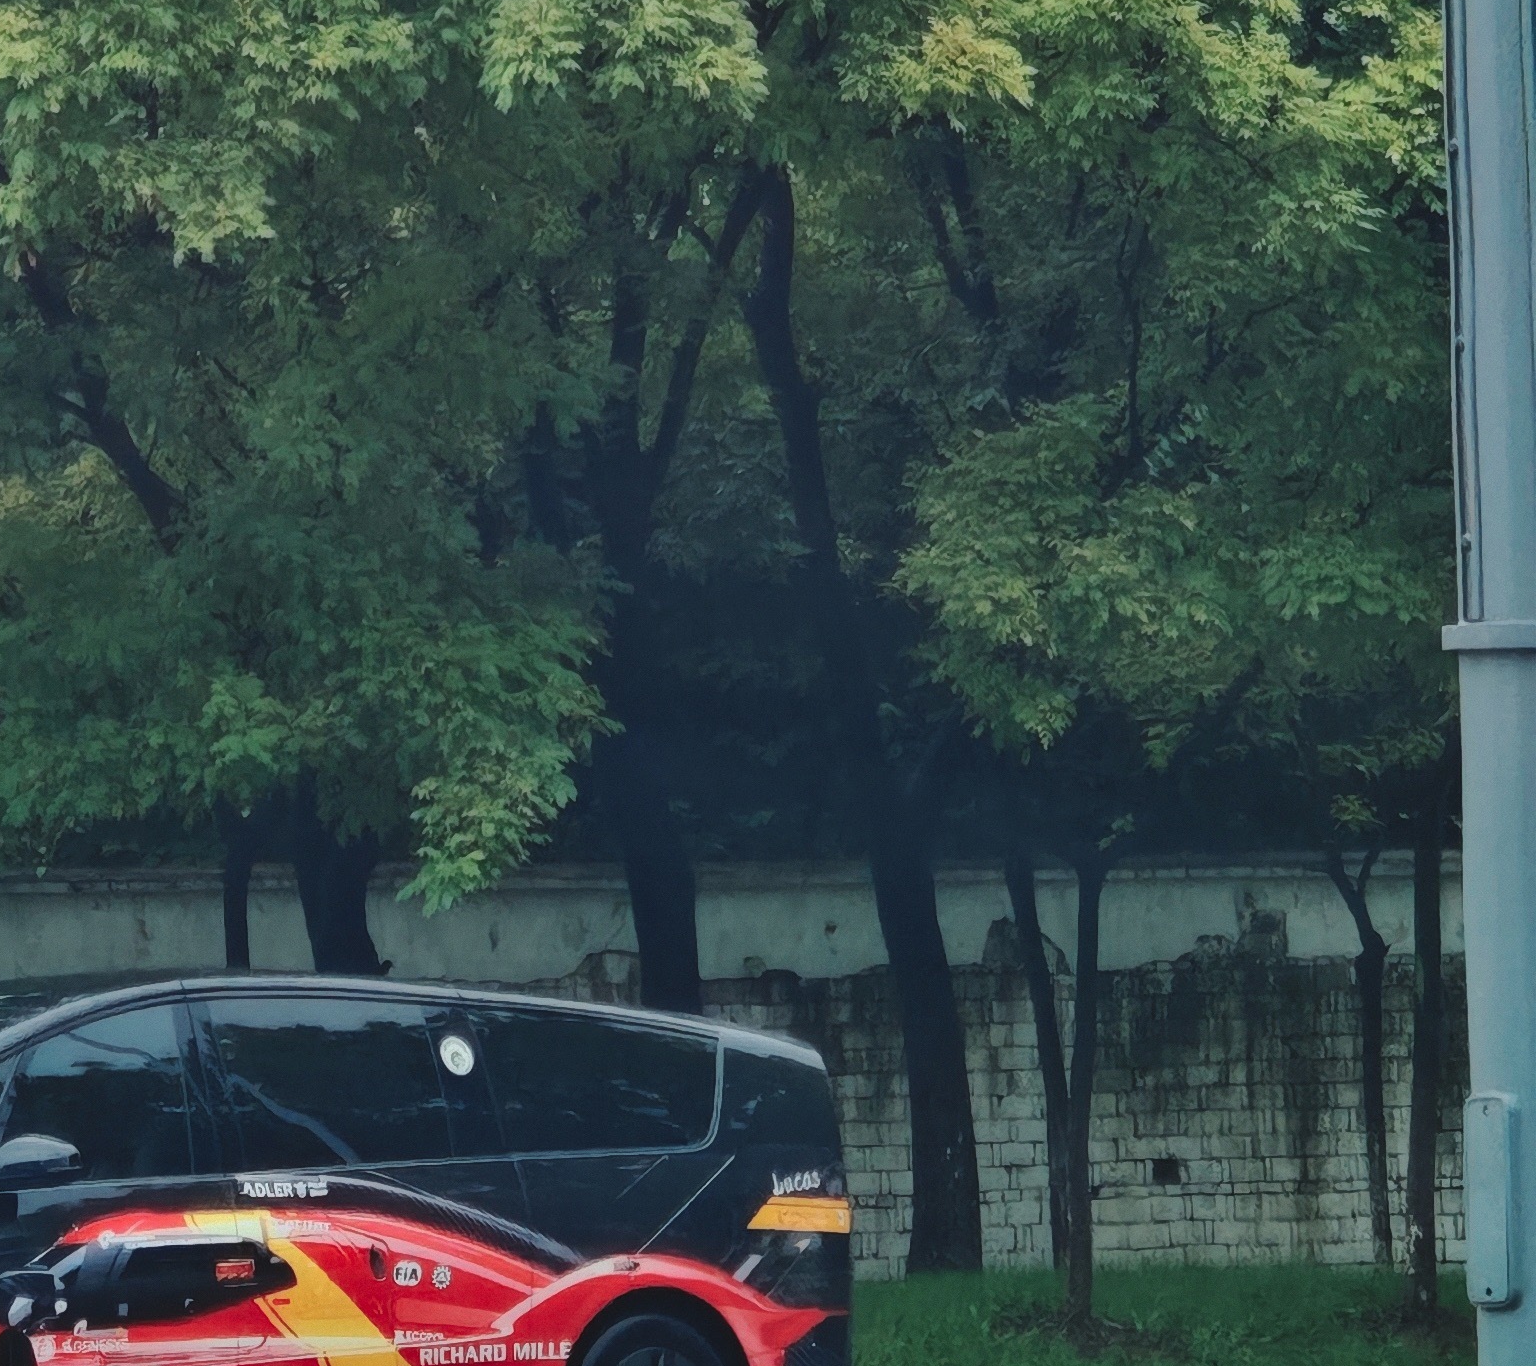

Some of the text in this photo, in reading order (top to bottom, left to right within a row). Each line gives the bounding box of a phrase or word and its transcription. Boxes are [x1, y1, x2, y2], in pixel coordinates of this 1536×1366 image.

[395, 1267, 419, 1282] FIA
[419, 1341, 571, 1366] RICHARD MILLE
